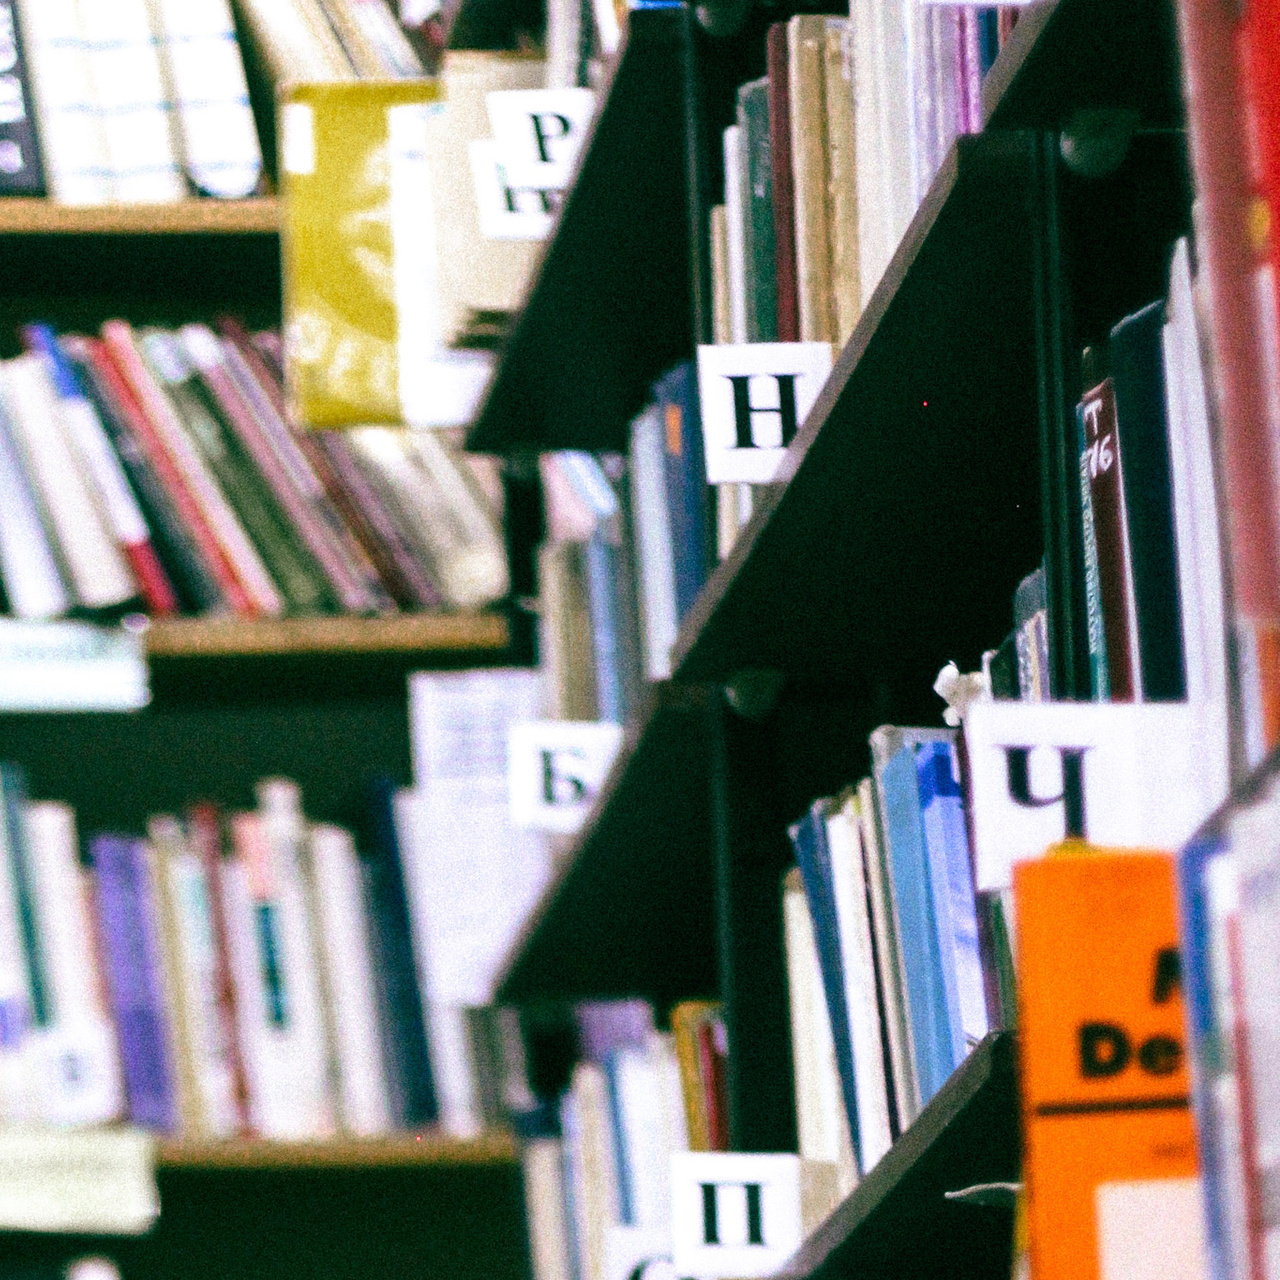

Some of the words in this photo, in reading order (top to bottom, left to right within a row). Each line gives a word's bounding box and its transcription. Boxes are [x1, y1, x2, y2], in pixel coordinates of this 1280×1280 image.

[528, 111, 572, 165] Р
[721, 372, 802, 450] Н
[538, 746, 589, 805] Б
[992, 742, 1096, 840] Ч
[698, 1180, 767, 1246] П
